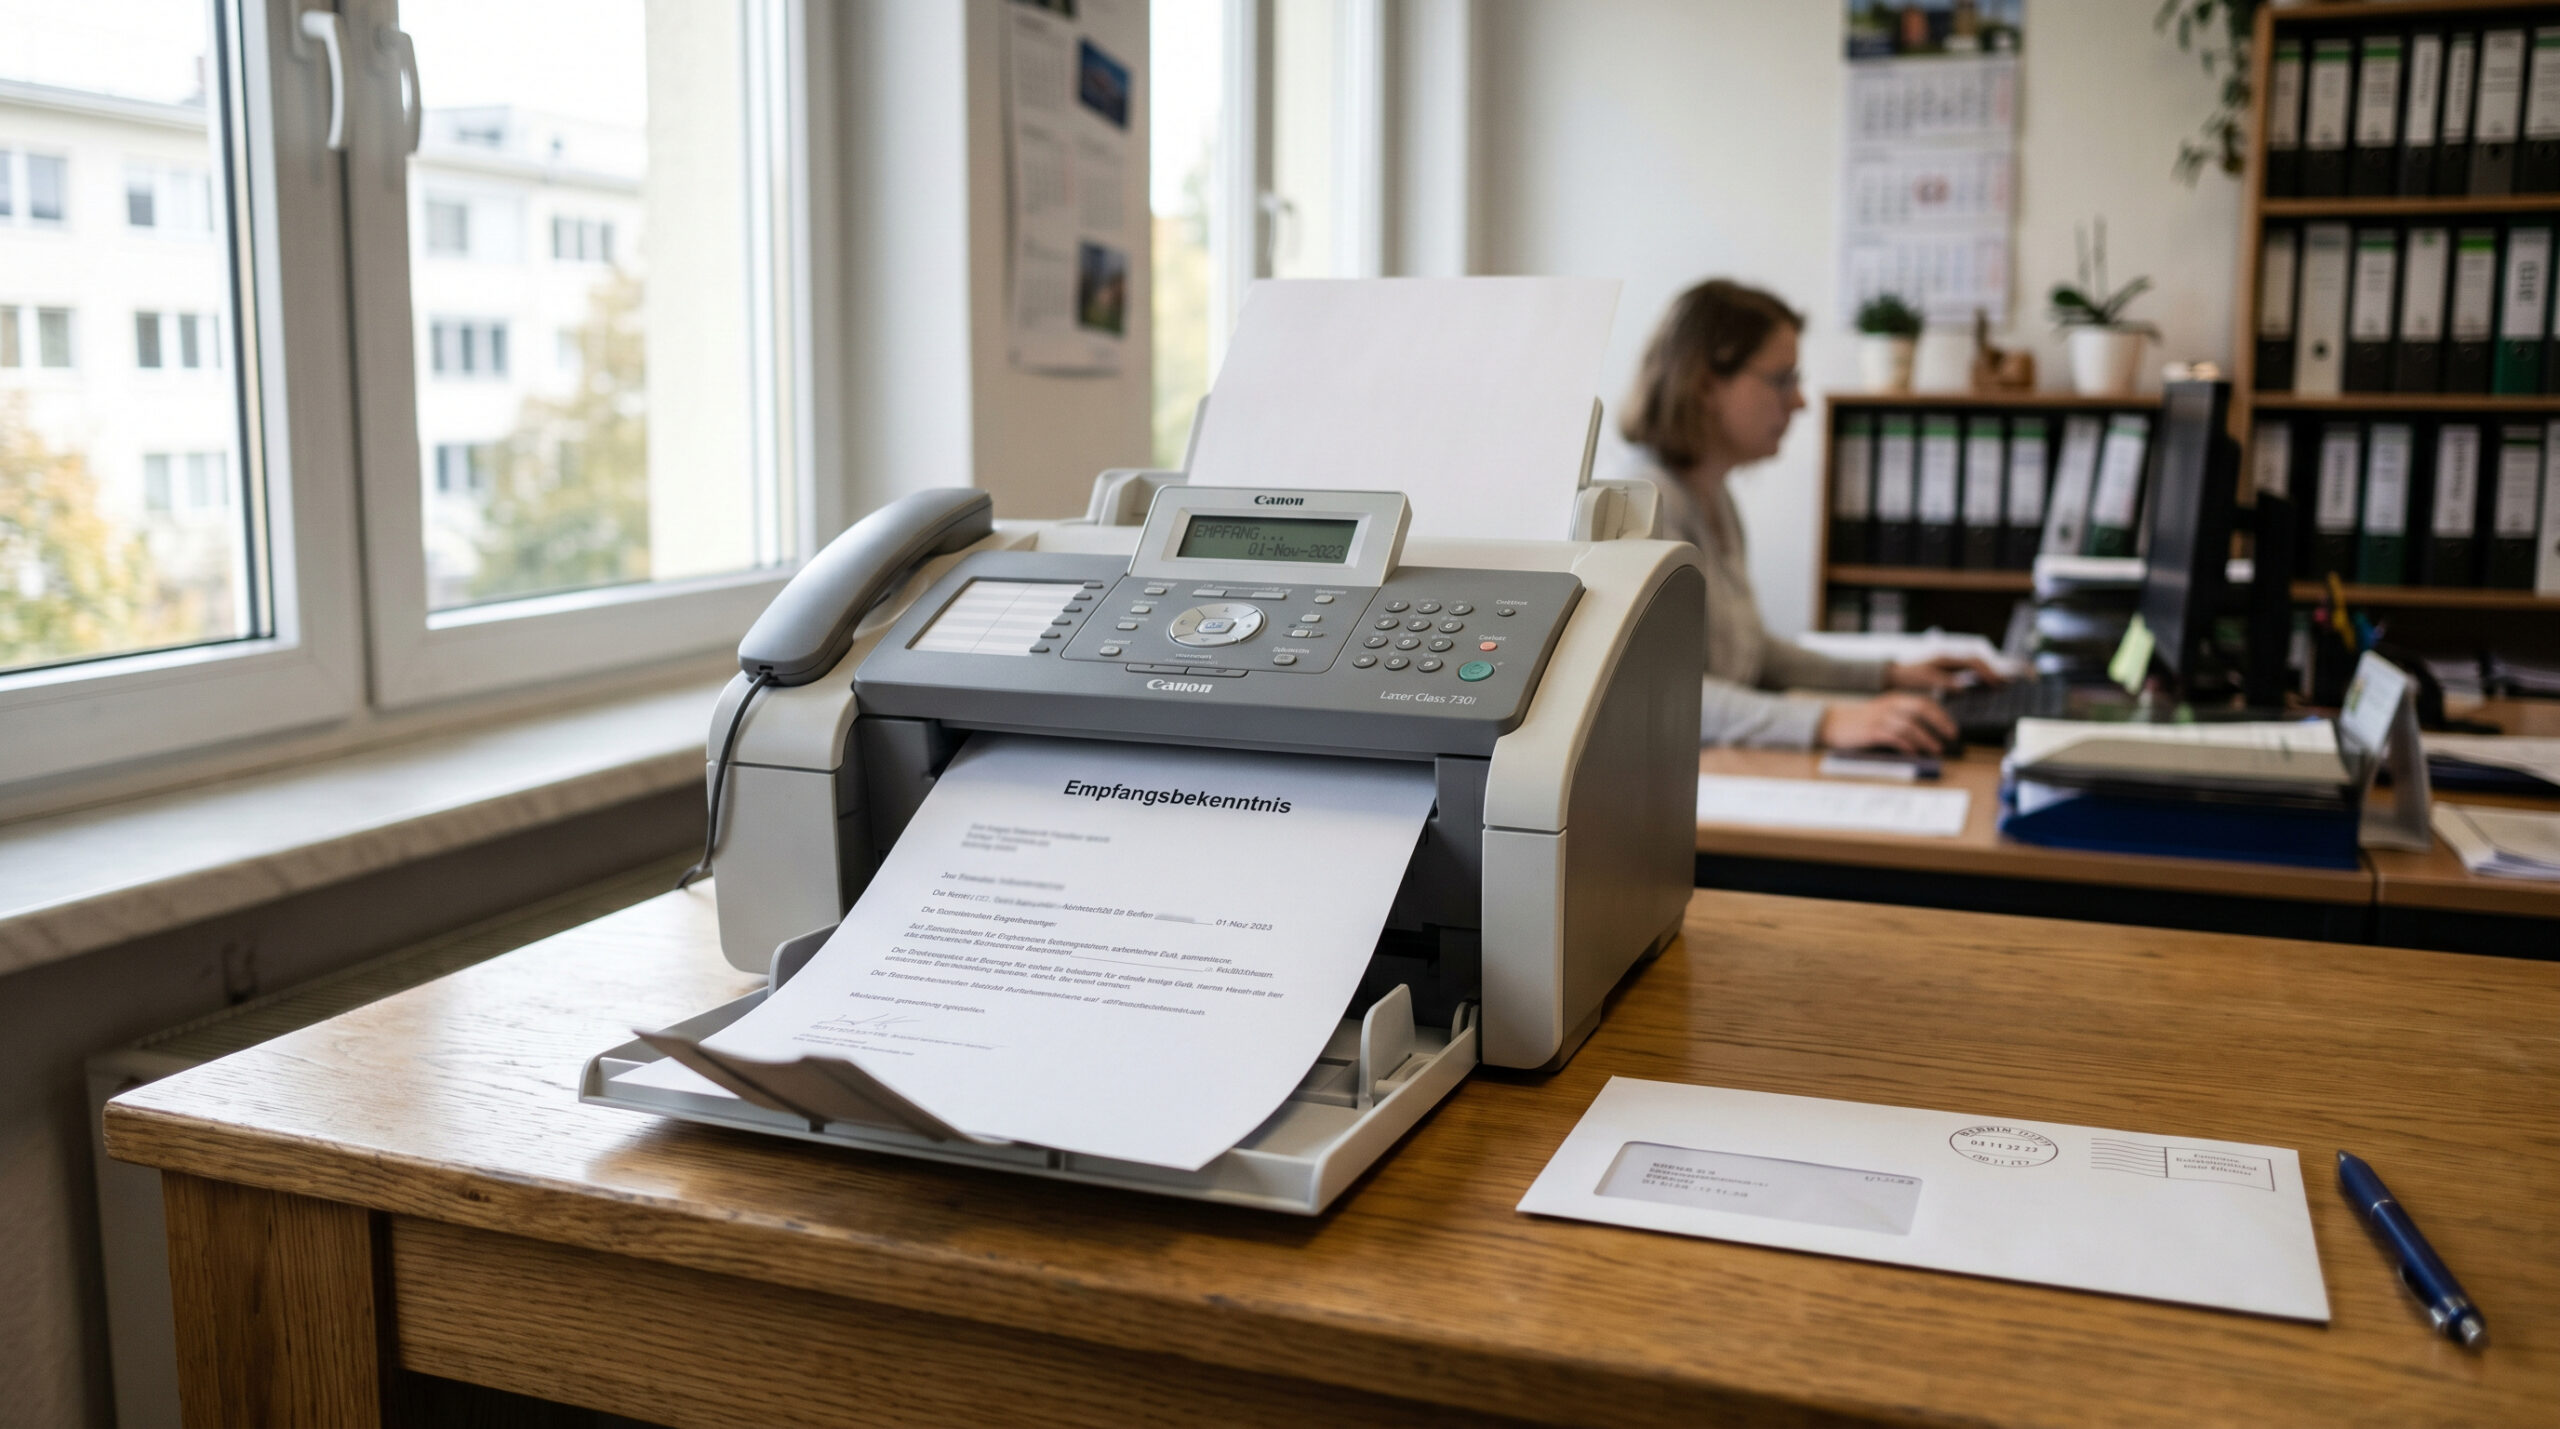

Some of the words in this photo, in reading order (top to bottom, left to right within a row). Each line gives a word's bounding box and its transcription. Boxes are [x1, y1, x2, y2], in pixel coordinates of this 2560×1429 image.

[1254, 495, 1304, 506] Canon
[1194, 524, 1284, 541] EMPFANG...
[1248, 543, 1345, 560] 01-Nov-2023
[1146, 678, 1213, 694] Canon
[1415, 692, 1446, 704] Class
[1063, 780, 1292, 813] Empfangsbekenntnis
[1250, 922, 1273, 931] 2023
